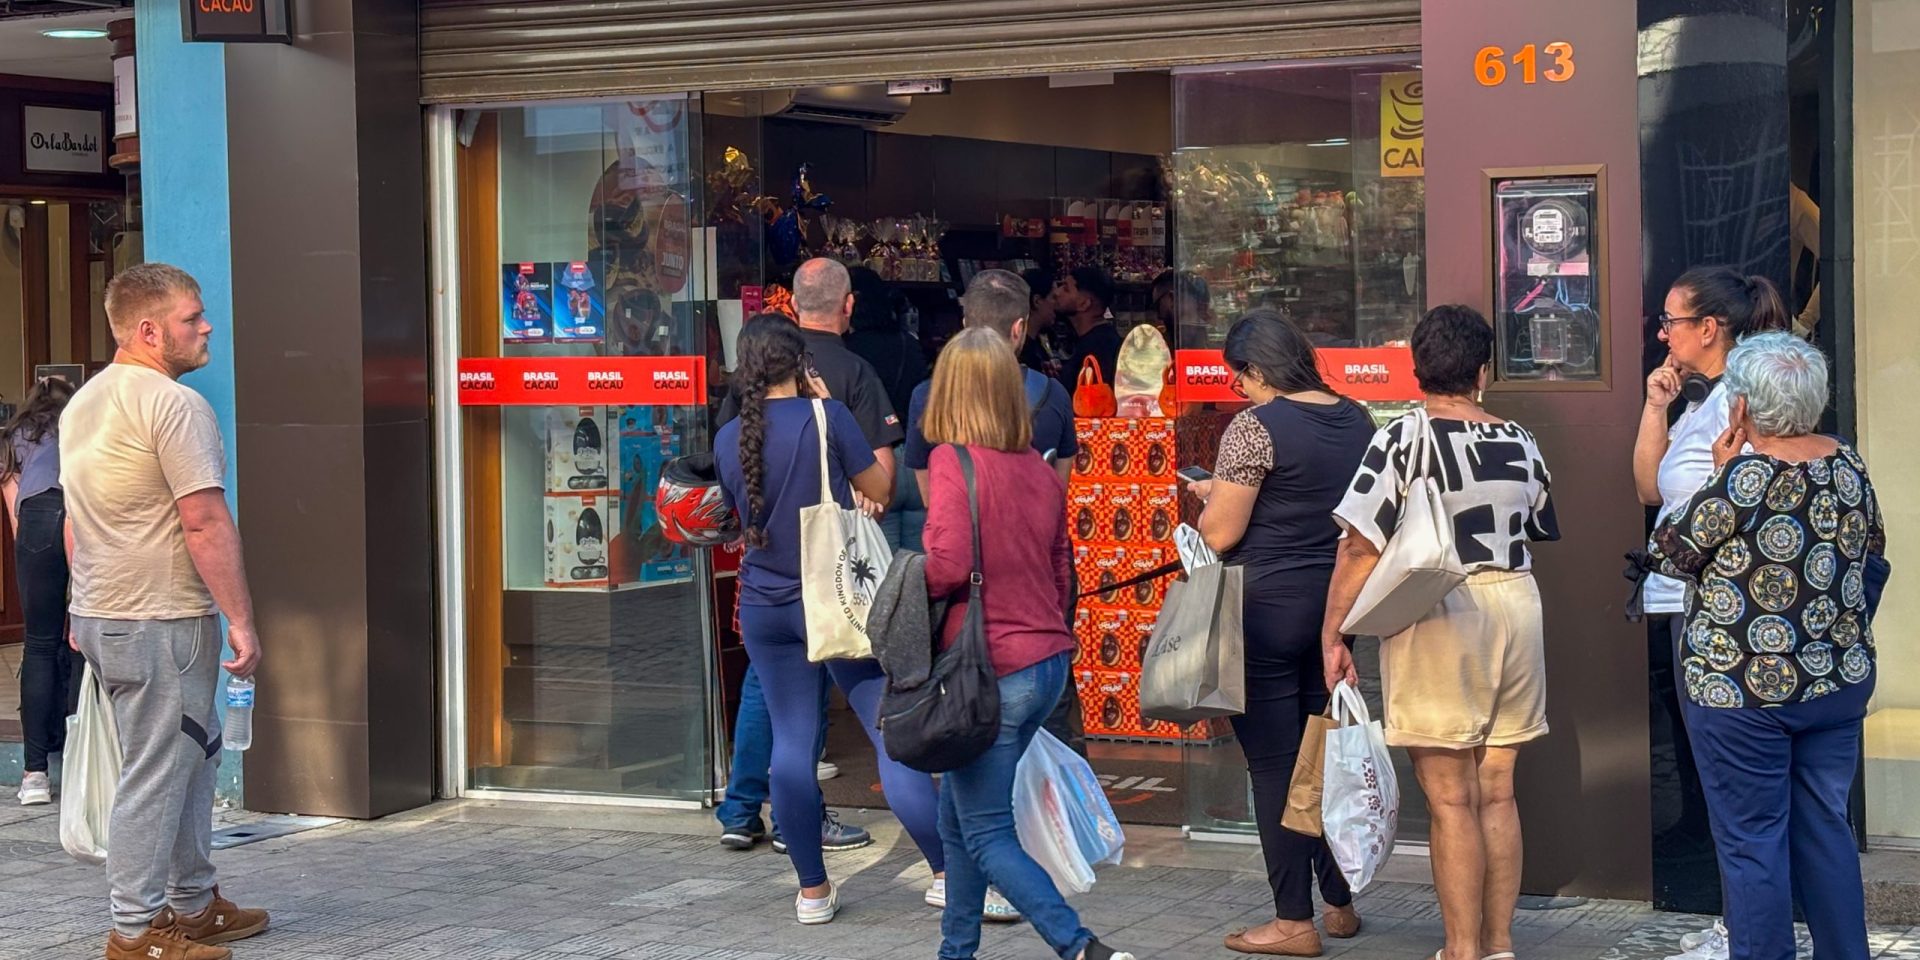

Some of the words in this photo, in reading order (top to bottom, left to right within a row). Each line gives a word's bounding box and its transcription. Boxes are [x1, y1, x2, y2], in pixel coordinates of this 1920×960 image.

[200, 0, 253, 13] CACAU
[1474, 41, 1575, 86] 613
[1383, 148, 1424, 169] CA
[1186, 366, 1228, 375] BRASIL
[1344, 364, 1389, 374] BRASIL
[460, 372, 494, 381] BRASIL
[523, 372, 559, 381] BRASIL
[587, 371, 623, 380] BRASIL
[652, 371, 689, 380] BRASIL
[1345, 374, 1389, 384] CACAU
[1187, 376, 1228, 385] CACAU
[461, 381, 495, 390] CACAU
[524, 381, 559, 390] CACAU
[588, 381, 624, 390] CACAU
[654, 381, 689, 390] CACAU
